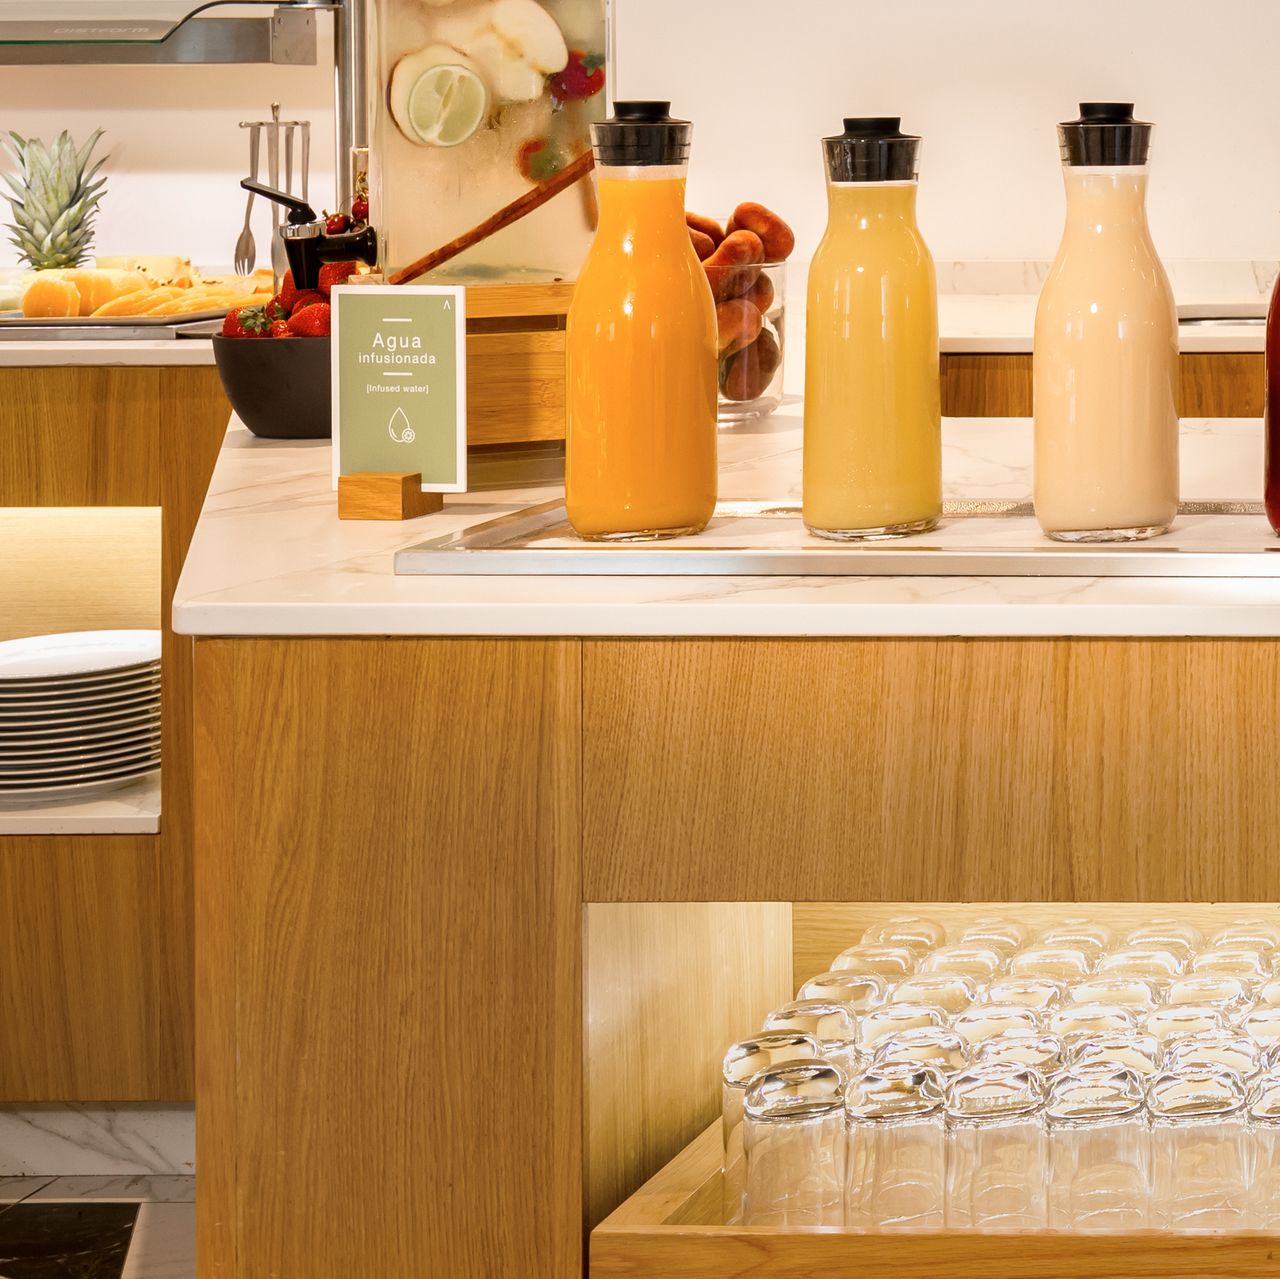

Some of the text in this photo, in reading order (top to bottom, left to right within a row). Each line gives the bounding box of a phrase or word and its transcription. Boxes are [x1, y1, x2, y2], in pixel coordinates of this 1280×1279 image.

[372, 332, 422, 352] Agua
[358, 352, 436, 365] infusionada
[366, 384, 429, 395] [Infused water]
